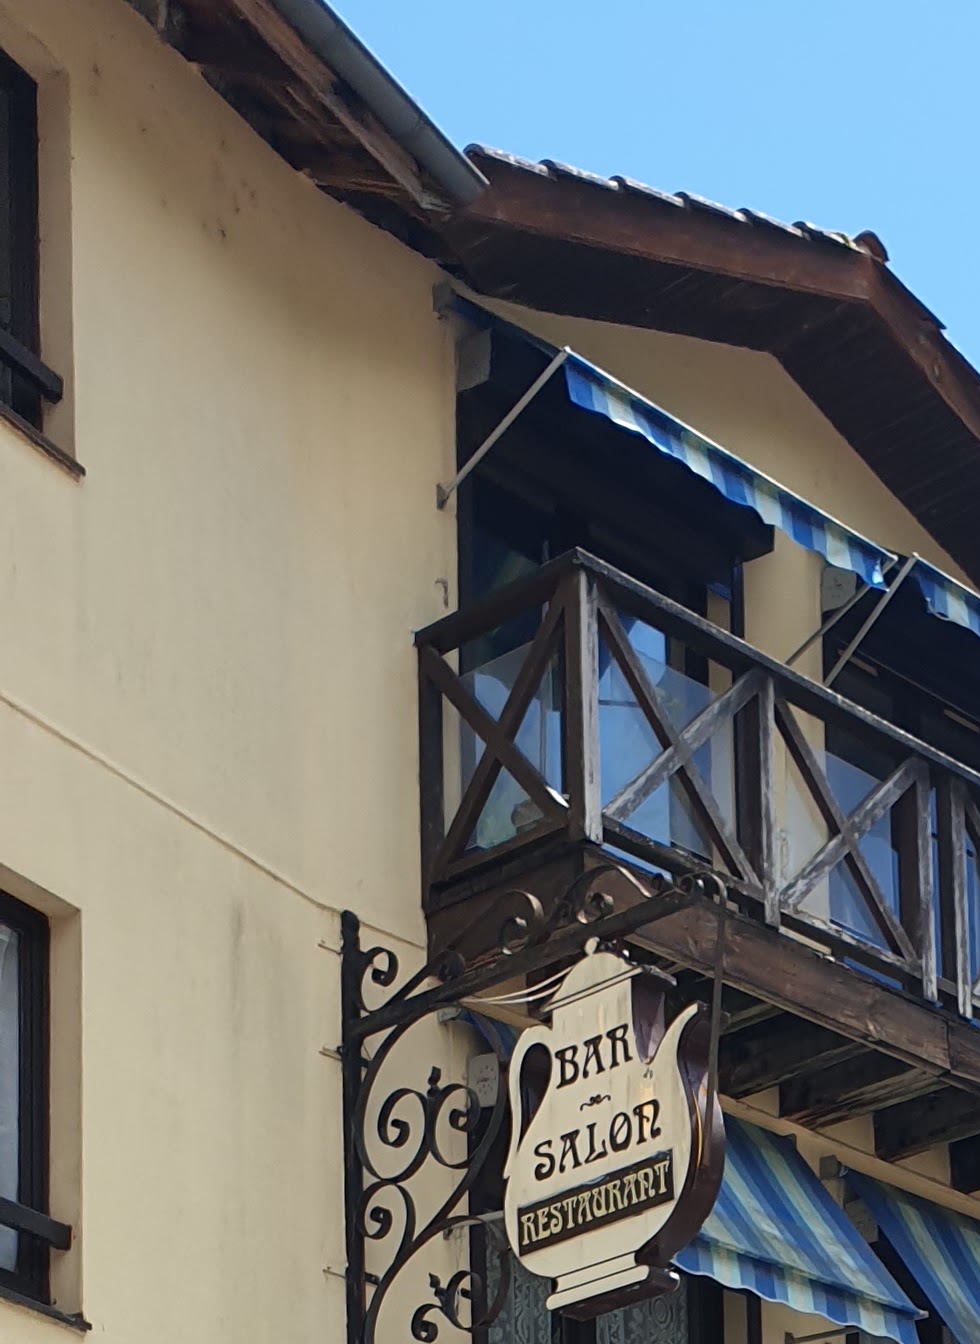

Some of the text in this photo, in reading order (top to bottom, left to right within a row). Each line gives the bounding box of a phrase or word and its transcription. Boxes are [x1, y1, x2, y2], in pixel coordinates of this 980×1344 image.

[554, 1023, 633, 1090] BAR
[533, 1098, 662, 1182] SALON
[520, 1159, 671, 1247] RESTAURANT
